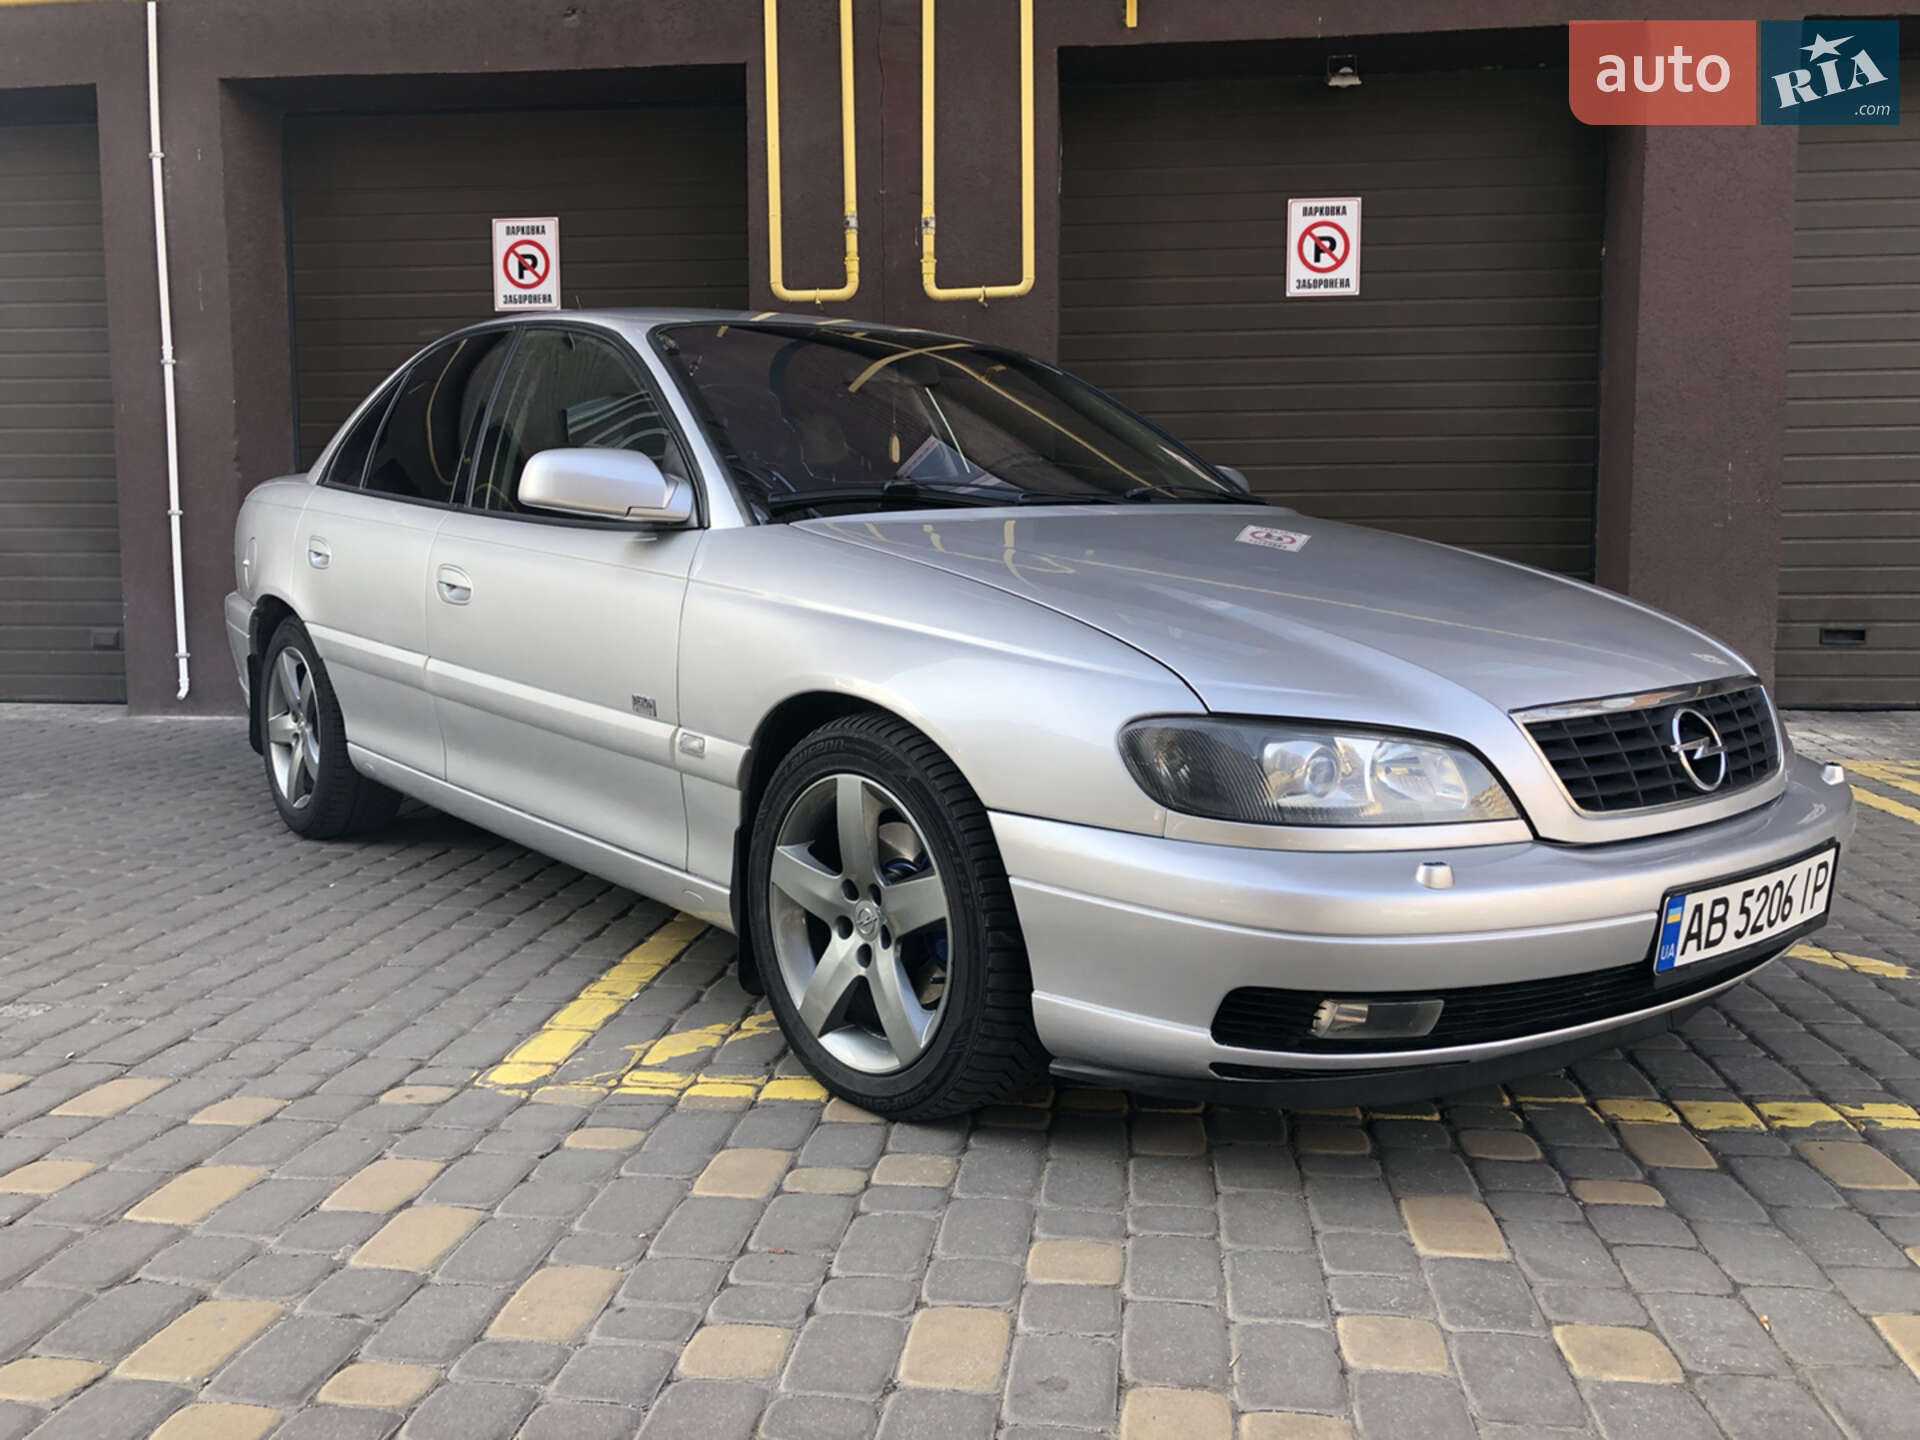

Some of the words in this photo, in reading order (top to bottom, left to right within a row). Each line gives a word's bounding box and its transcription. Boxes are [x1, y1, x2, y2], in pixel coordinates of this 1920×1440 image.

[1302, 206, 1347, 216] ПАРКОВКА
[505, 225, 546, 236] ПАРКОВКА
[1296, 278, 1351, 289] ЗАБОРОНЕНА
[503, 294, 552, 304] ЗАБОРОНЕНА
[1680, 896, 1729, 956] AB
[1733, 873, 1798, 940] 5206
[1800, 860, 1829, 914] IP
[1660, 944, 1675, 960] UA
